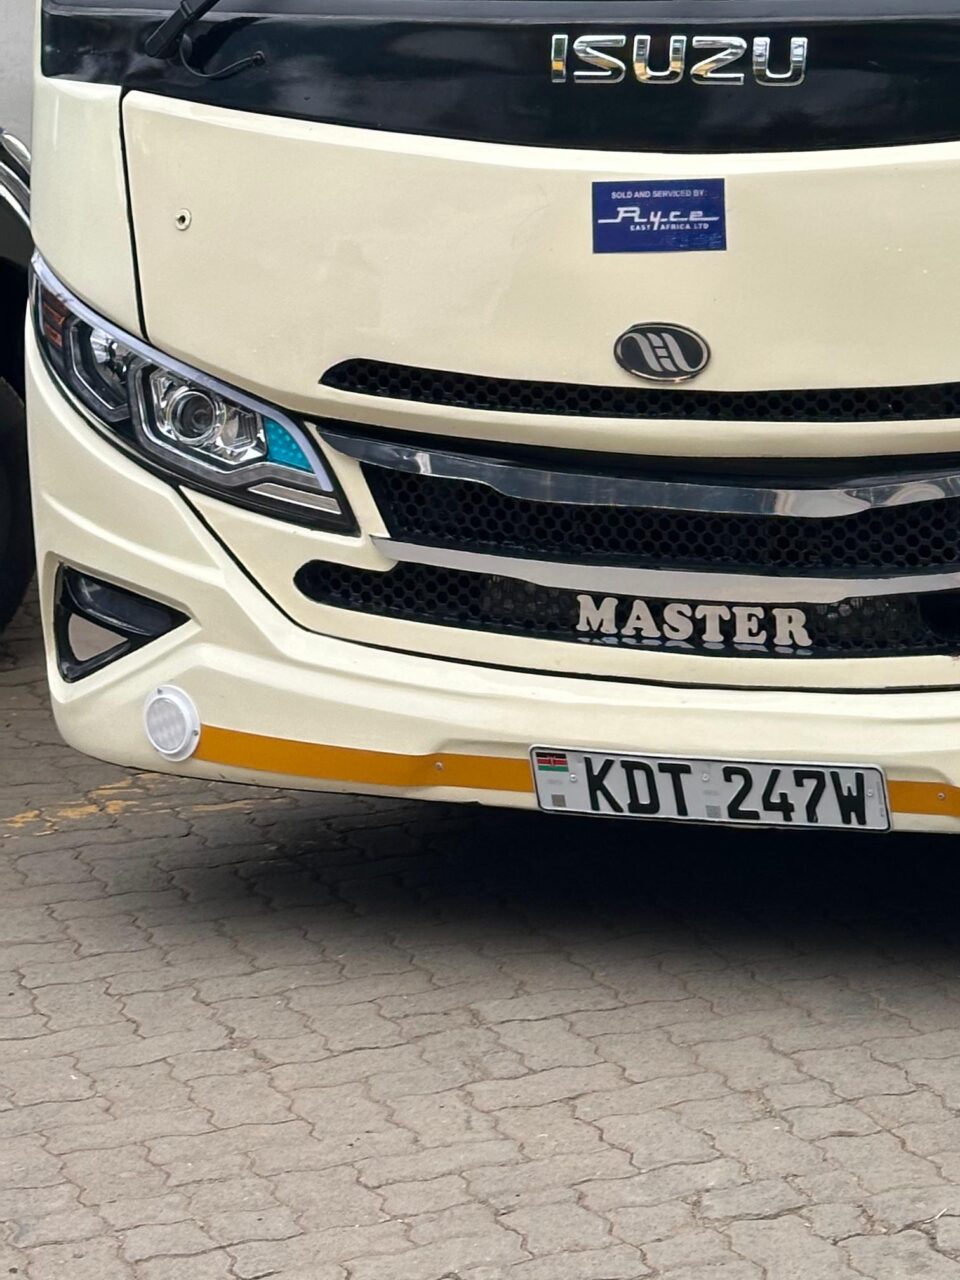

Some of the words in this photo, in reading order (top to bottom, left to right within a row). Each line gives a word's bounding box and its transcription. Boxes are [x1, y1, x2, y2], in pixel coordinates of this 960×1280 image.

[551, 34, 808, 87] ISUZU
[611, 191, 633, 200] SOLD
[633, 190, 651, 199] AND
[652, 189, 692, 198] SERVICED
[597, 206, 720, 231] Ryce
[630, 223, 651, 232] EAST
[660, 223, 691, 231] AFRICA
[693, 222, 709, 230] LTD
[575, 593, 813, 647] MASTER
[583, 756, 693, 817] KDT
[721, 765, 868, 826] 247W
